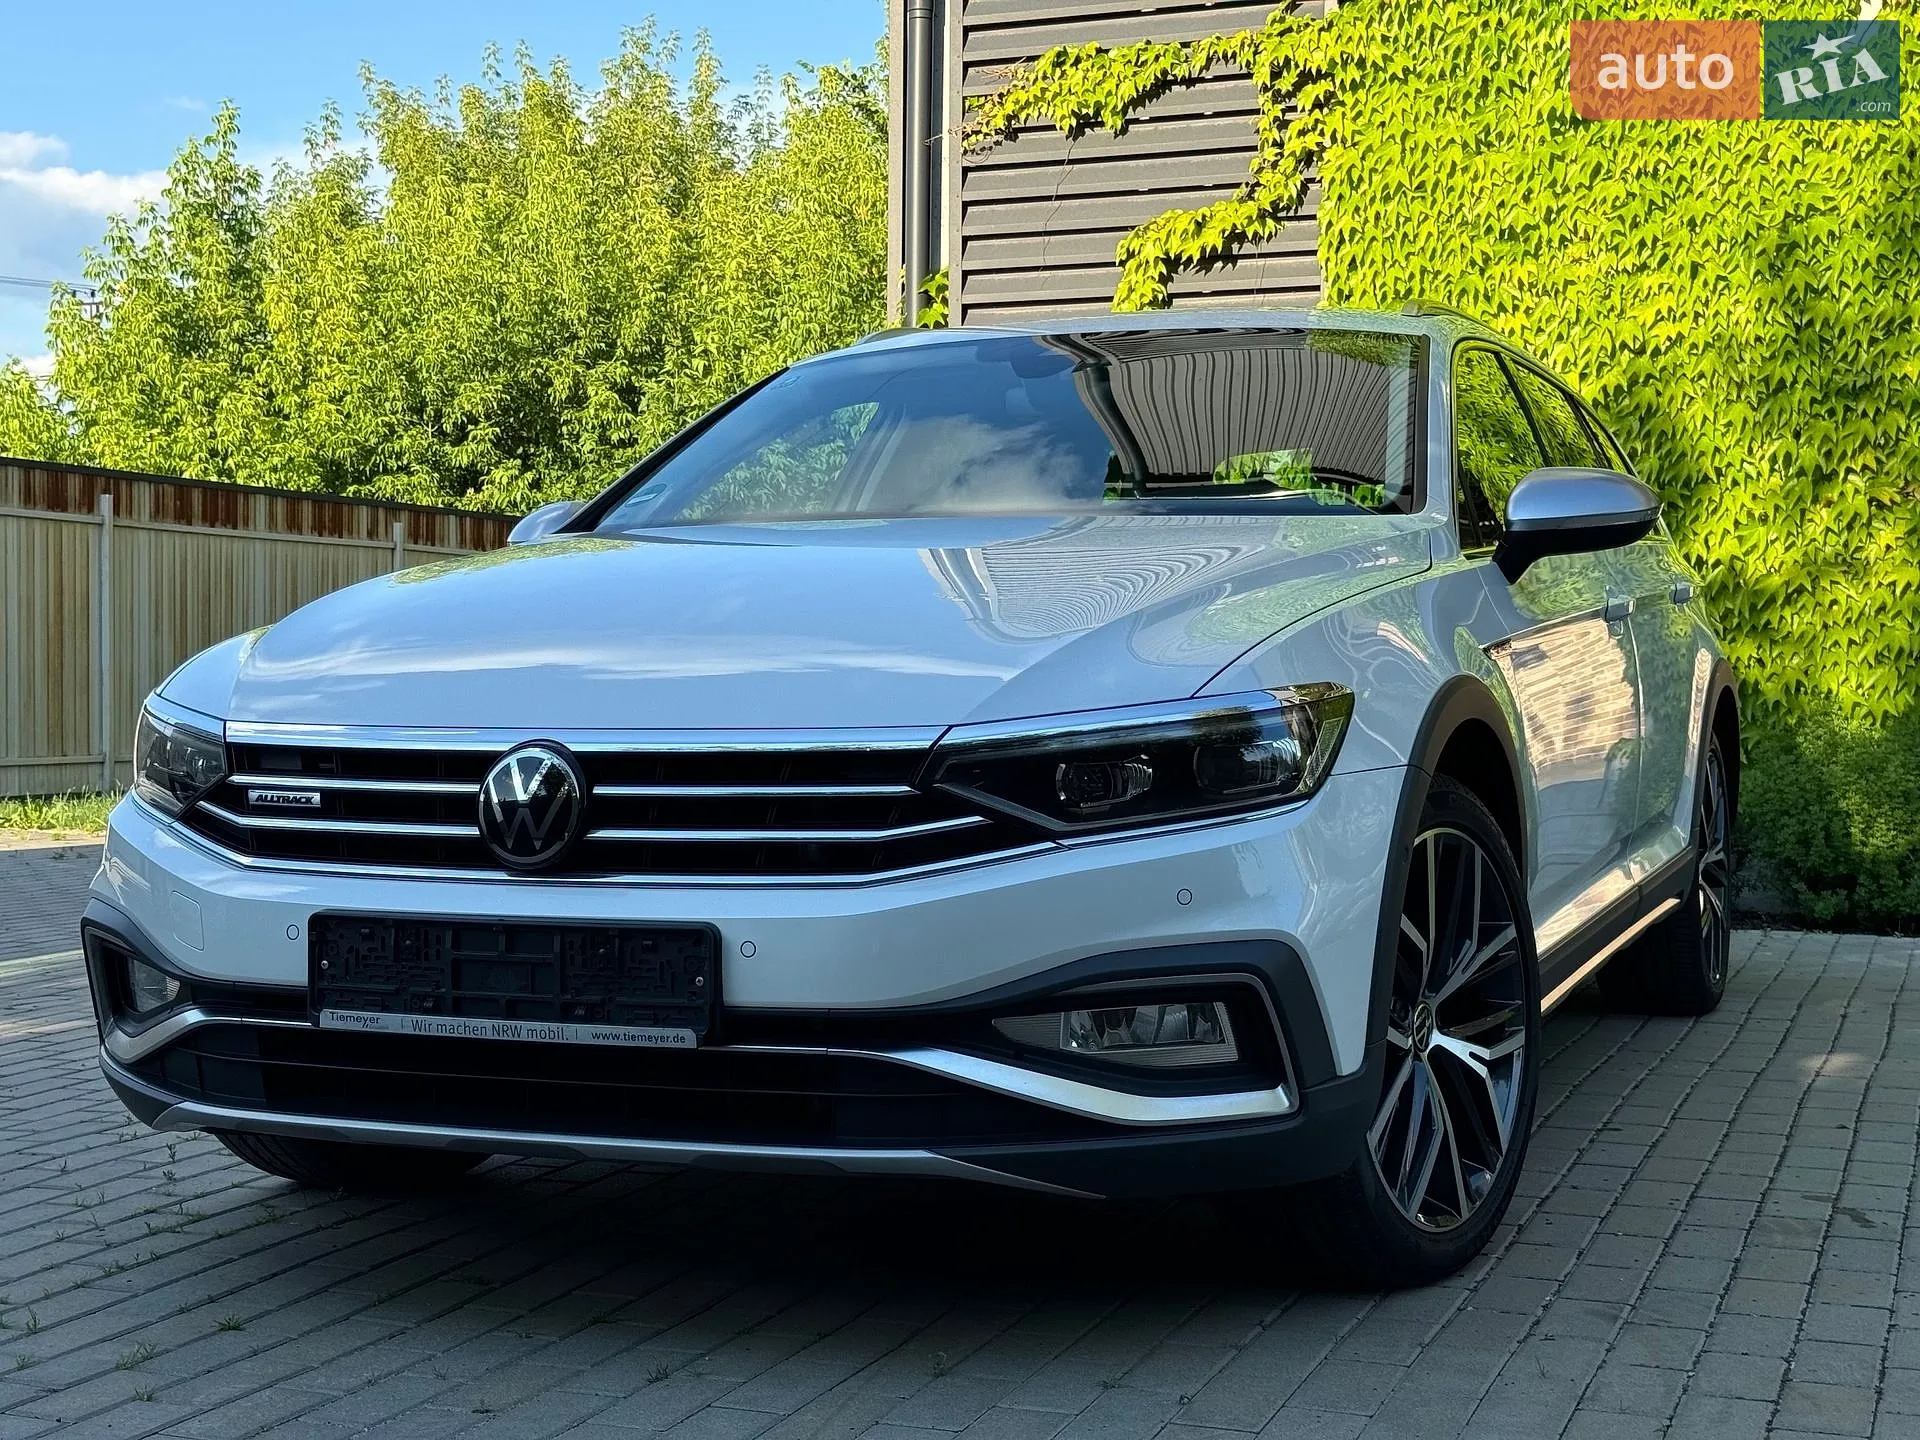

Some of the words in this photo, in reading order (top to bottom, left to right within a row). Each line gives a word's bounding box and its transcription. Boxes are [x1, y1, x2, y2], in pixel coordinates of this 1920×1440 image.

[254, 793, 316, 806] ALLTRACK
[328, 1011, 381, 1028] Tiemeyer
[411, 1018, 433, 1034] Wir
[436, 1021, 488, 1037] machen
[491, 1023, 523, 1039] NRW
[526, 1026, 569, 1041] mobil.
[591, 1030, 686, 1045] www.tiemeyer.de
